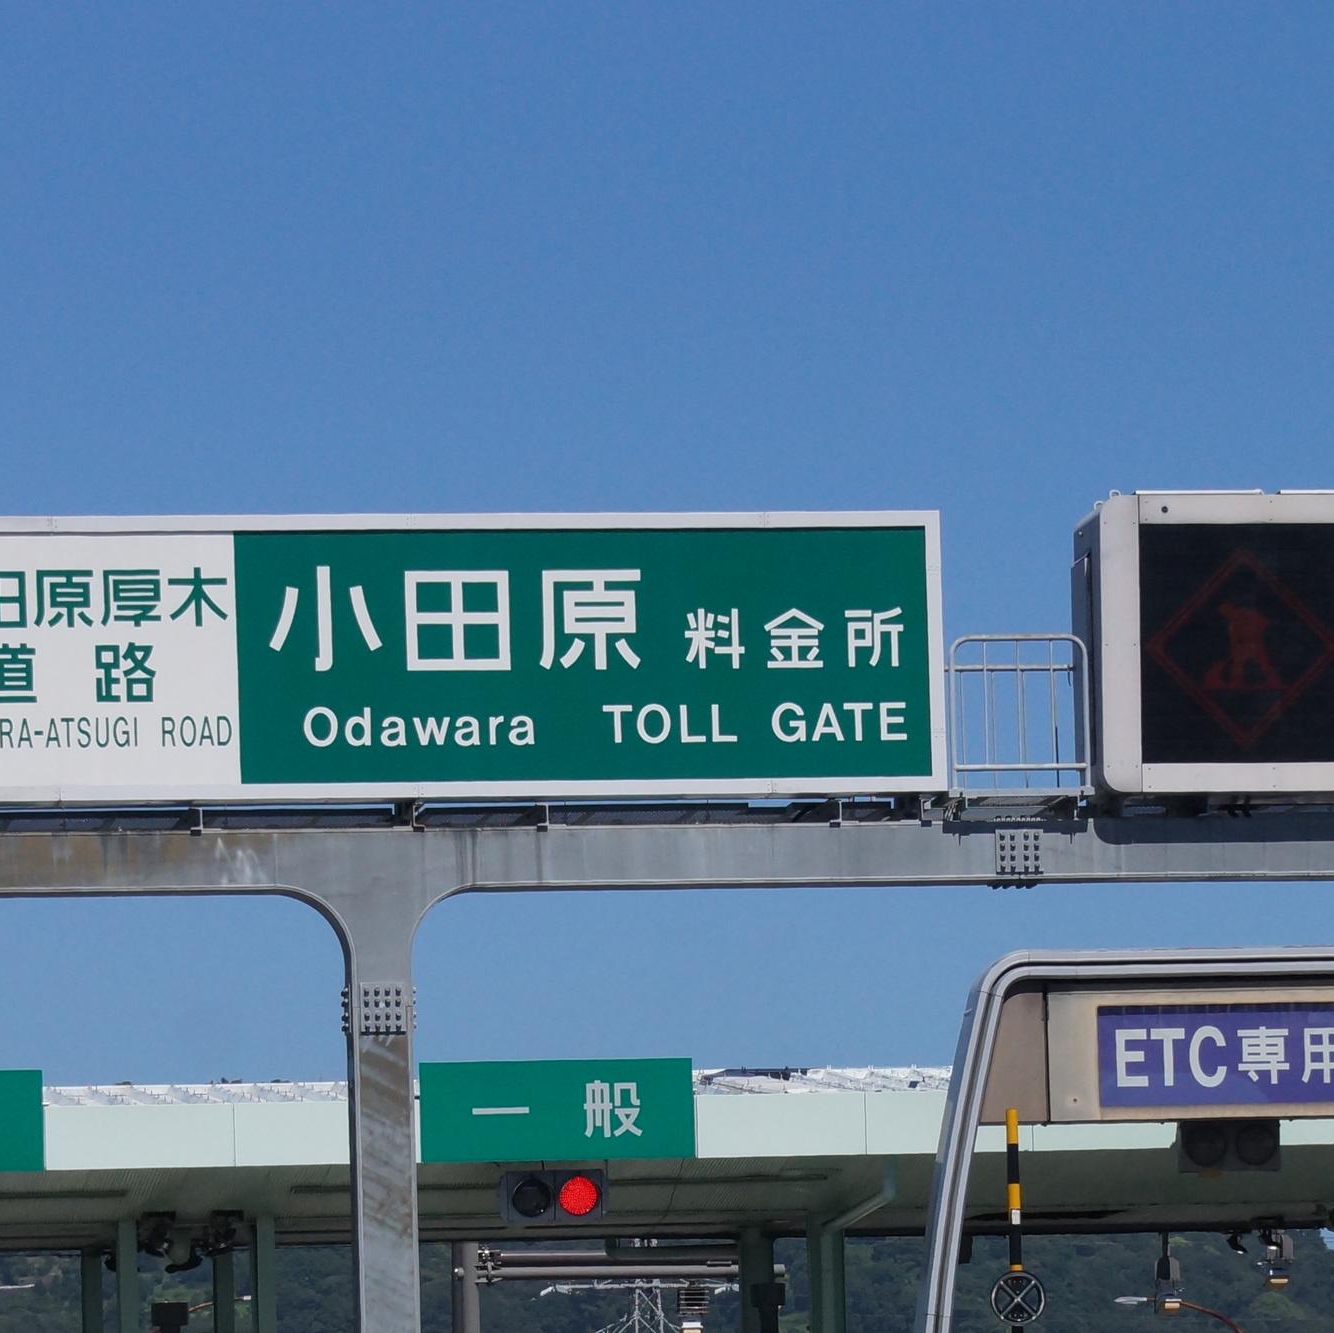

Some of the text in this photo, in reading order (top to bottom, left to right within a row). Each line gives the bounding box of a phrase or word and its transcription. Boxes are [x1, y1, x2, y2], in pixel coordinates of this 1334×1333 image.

[269, 565, 905, 672] 小田原 料金所
[161, 715, 232, 750] ROAD
[303, 702, 908, 749] Odawara TOLL GATE
[471, 1080, 644, 1139] 一般
